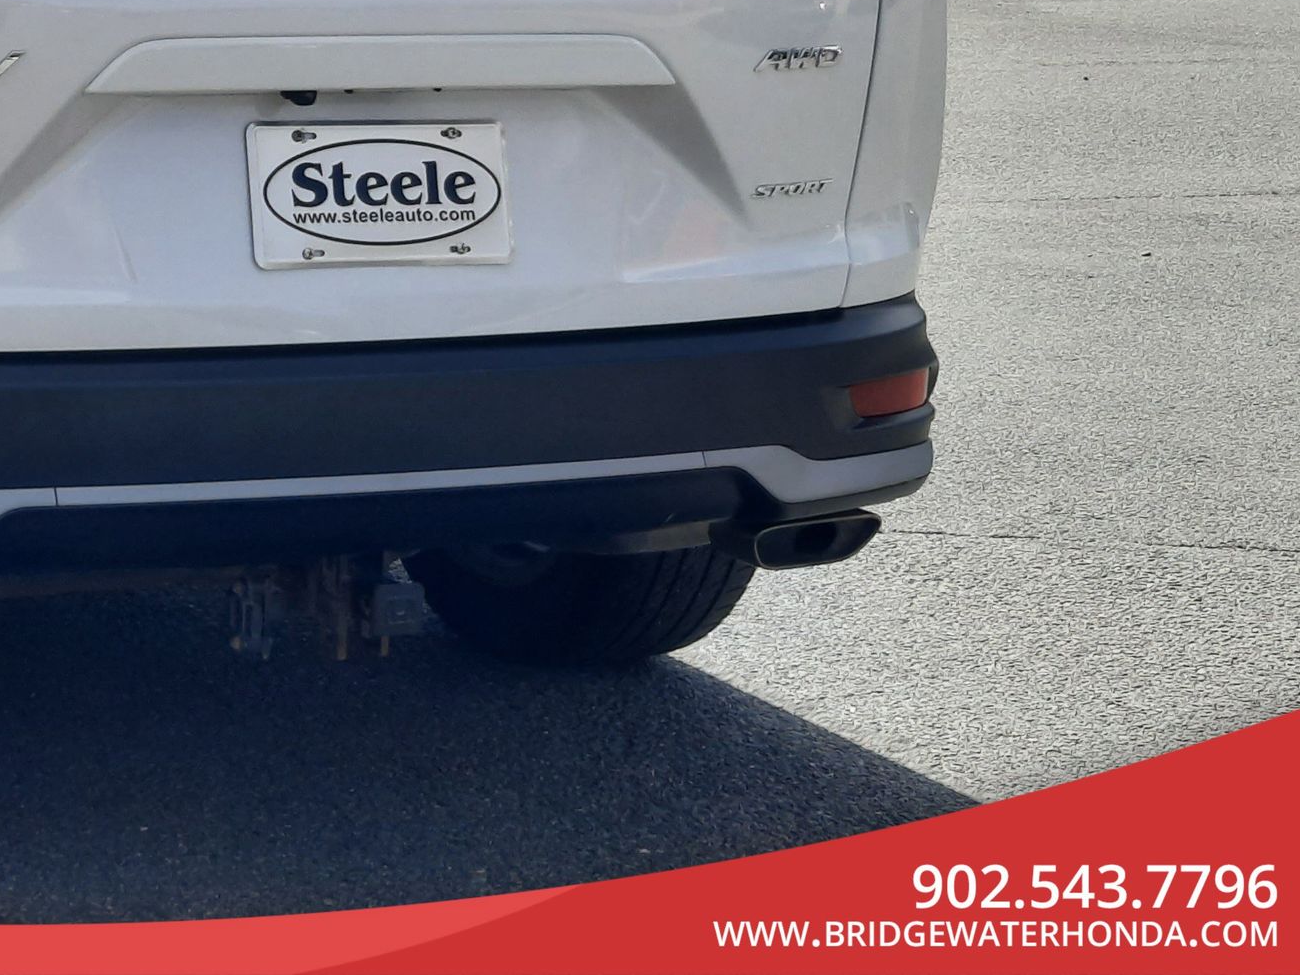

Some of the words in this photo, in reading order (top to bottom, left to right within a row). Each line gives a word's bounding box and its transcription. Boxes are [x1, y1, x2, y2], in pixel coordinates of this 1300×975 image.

[753, 44, 843, 72] AWD
[291, 161, 477, 208] Steele
[753, 178, 834, 198] SPORT
[293, 207, 477, 225] www.steeleauto.com
